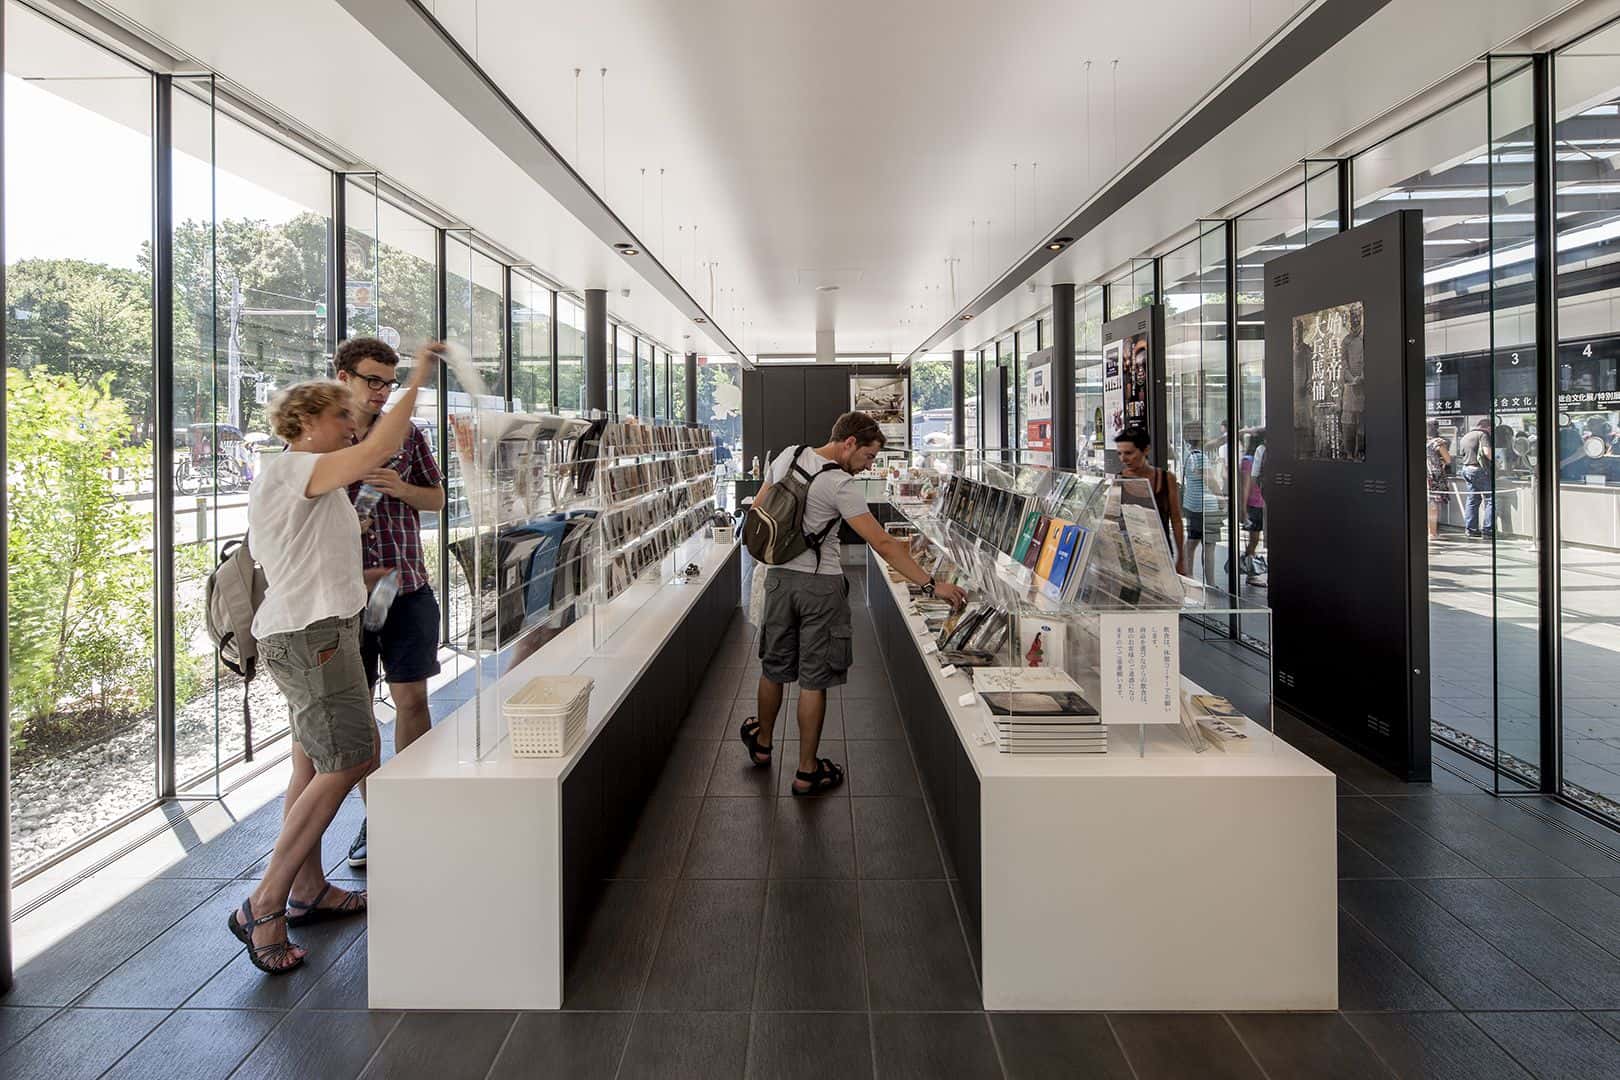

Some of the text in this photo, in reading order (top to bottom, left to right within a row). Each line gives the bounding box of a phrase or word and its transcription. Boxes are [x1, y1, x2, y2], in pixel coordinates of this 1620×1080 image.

[1583, 344, 1593, 358] 4
[1511, 353, 1520, 365] 3
[1435, 362, 1443, 374] 2
